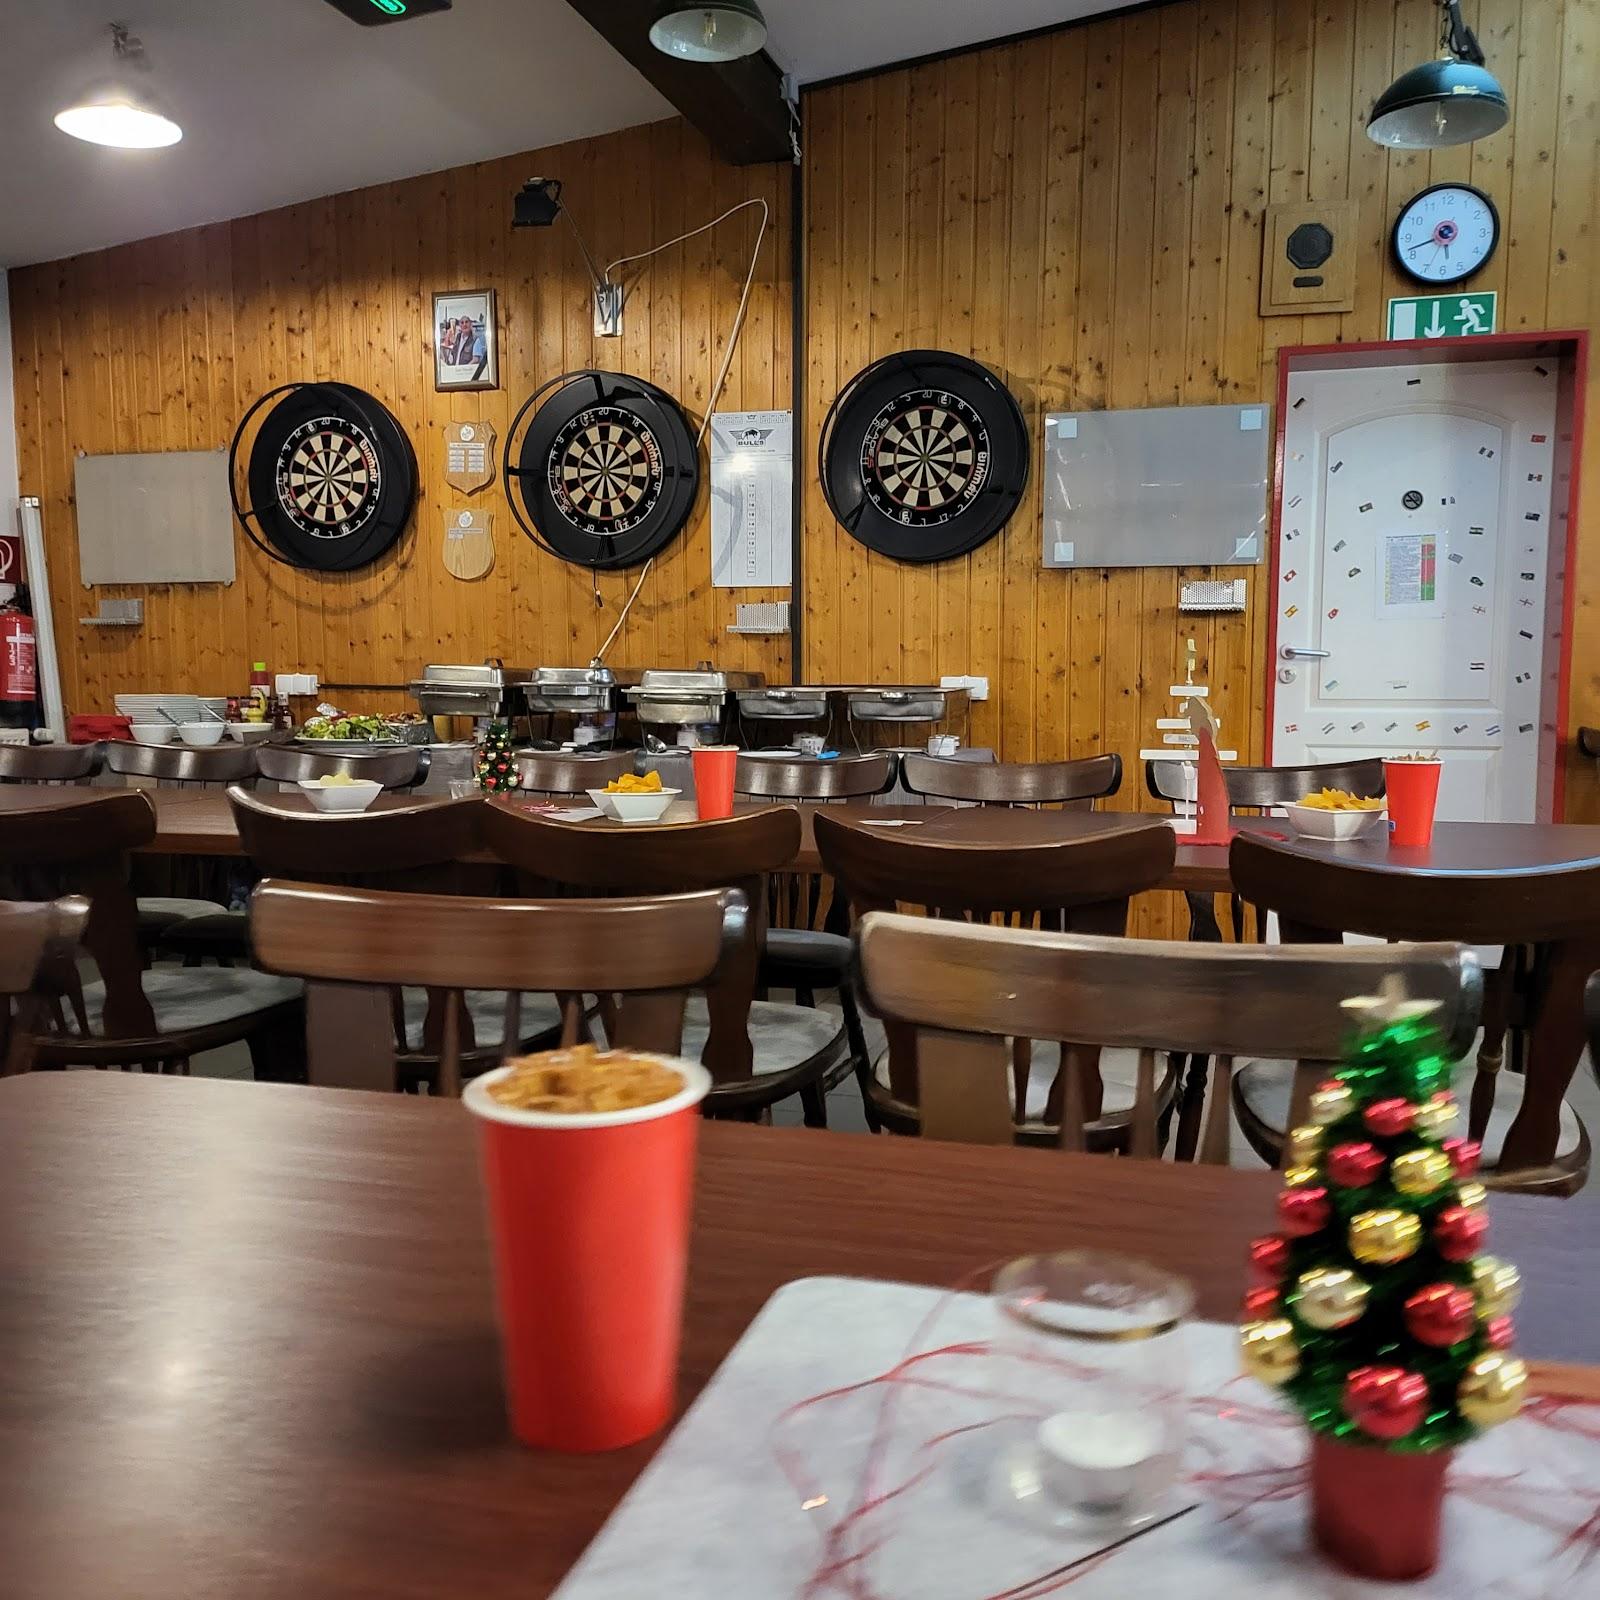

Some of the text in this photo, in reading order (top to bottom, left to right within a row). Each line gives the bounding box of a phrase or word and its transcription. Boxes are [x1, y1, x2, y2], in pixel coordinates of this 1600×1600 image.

[1442, 196, 1454, 205] 12
[1424, 202, 1435, 211] 11
[1474, 210, 1481, 220] 2
[1411, 216, 1423, 226] 10
[1480, 228, 1487, 238] 3
[1405, 233, 1412, 243] 9
[1473, 246, 1480, 255] 4
[1410, 251, 1417, 260] 8
[1423, 264, 1430, 273] 7
[1440, 265, 1446, 275] 6
[1456, 262, 1464, 271] 5
